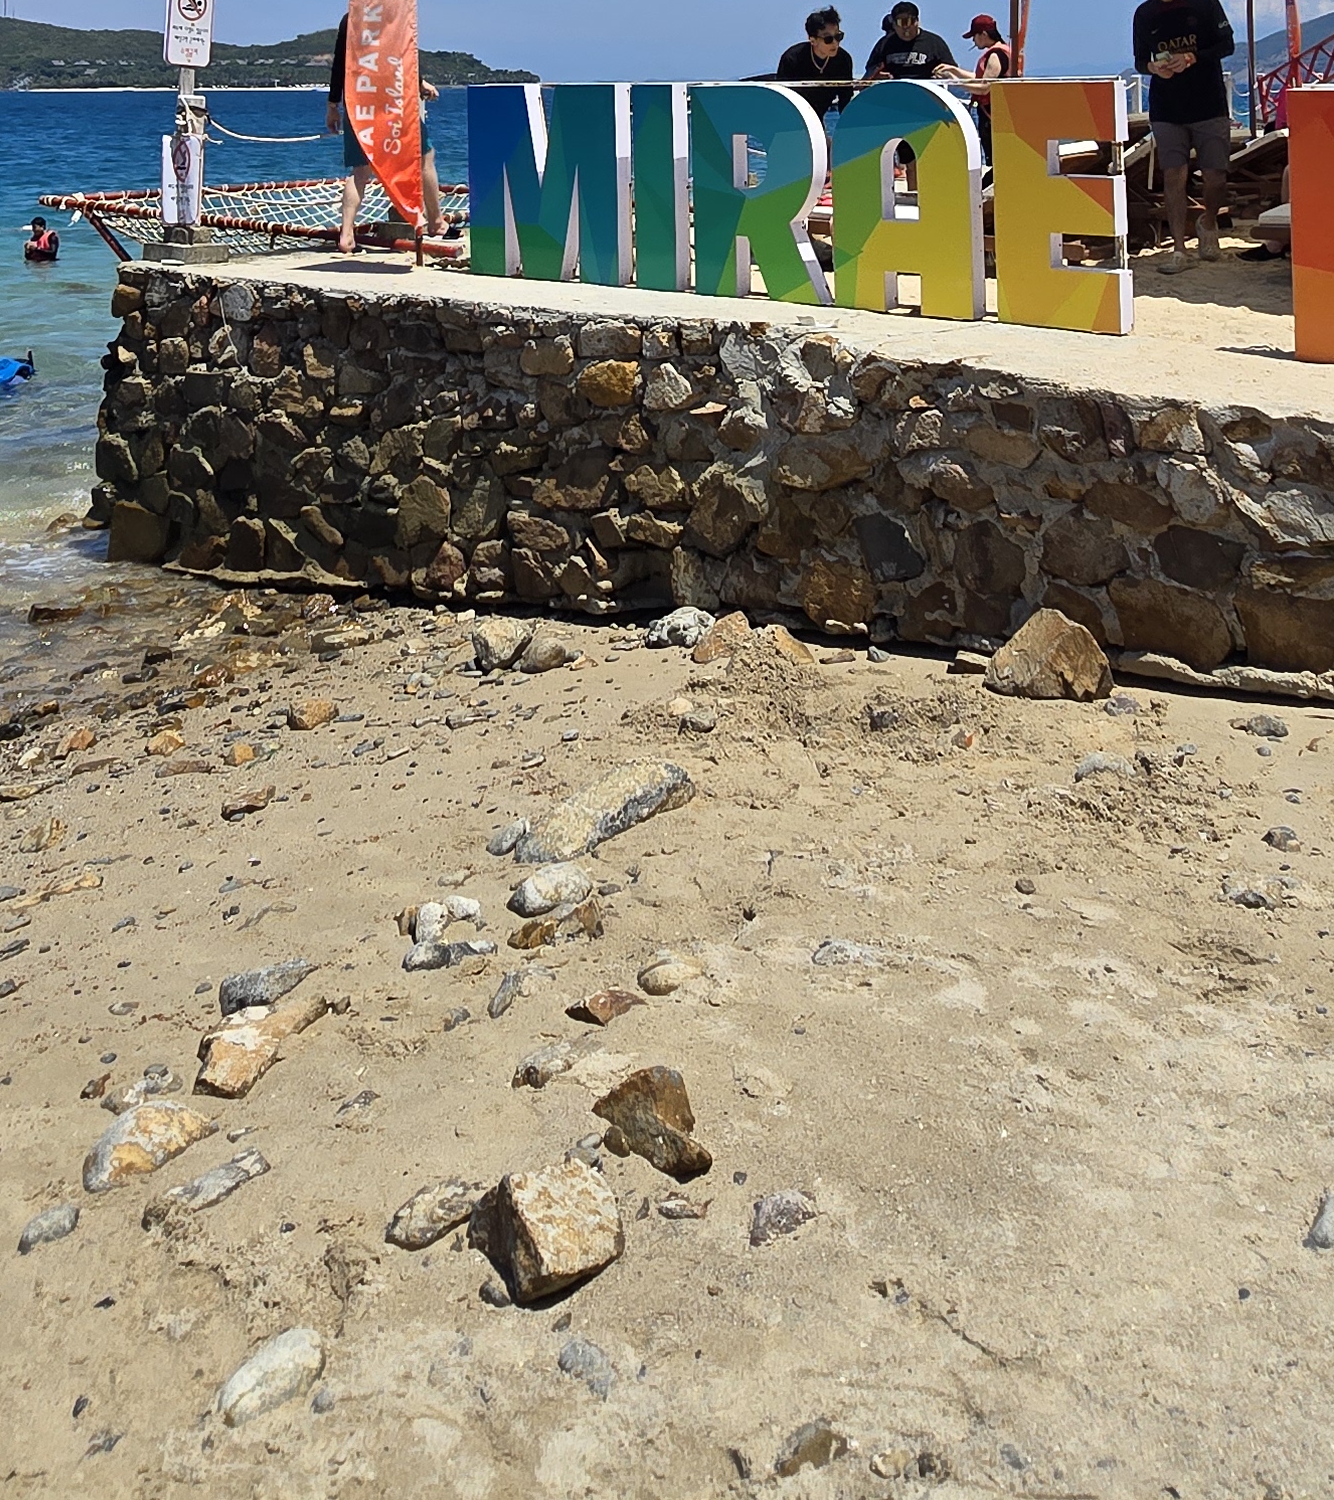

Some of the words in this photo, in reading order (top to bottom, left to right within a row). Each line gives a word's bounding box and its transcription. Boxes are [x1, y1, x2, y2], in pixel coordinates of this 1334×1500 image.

[357, 5, 383, 92] PARK
[1157, 33, 1197, 51] QATAR
[385, 56, 403, 117] Island
[357, 105, 375, 162] AE
[383, 120, 402, 154] Soi
[468, 80, 1134, 335] MIRAE
